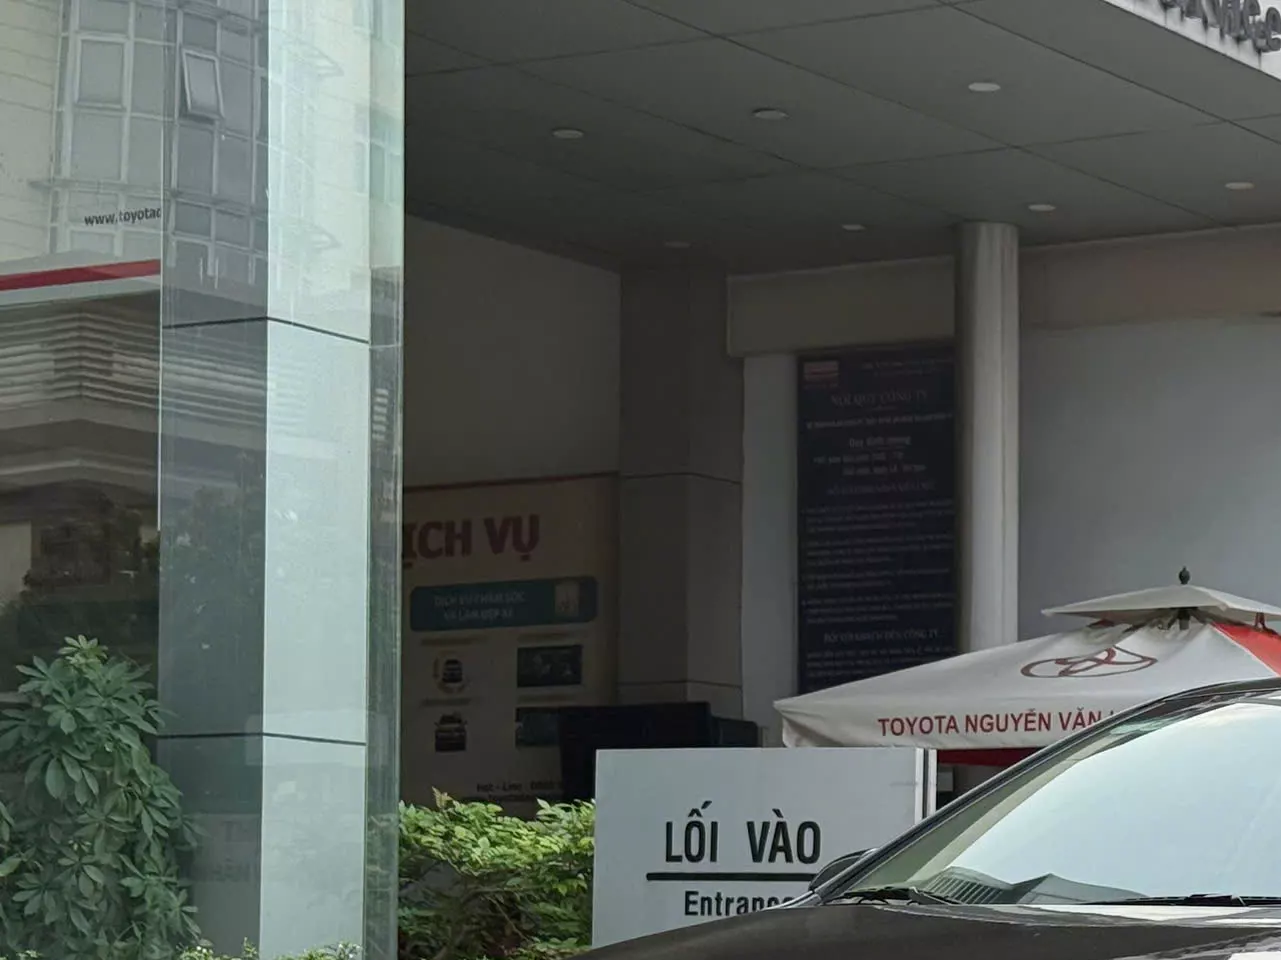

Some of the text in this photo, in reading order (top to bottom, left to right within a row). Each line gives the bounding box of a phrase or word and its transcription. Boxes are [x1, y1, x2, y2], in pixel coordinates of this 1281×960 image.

[484, 514, 540, 562] VỤ
[878, 706, 1102, 737] TOYOTA NGUYỄN VĂN
[665, 800, 821, 864] LỐI VÀO
